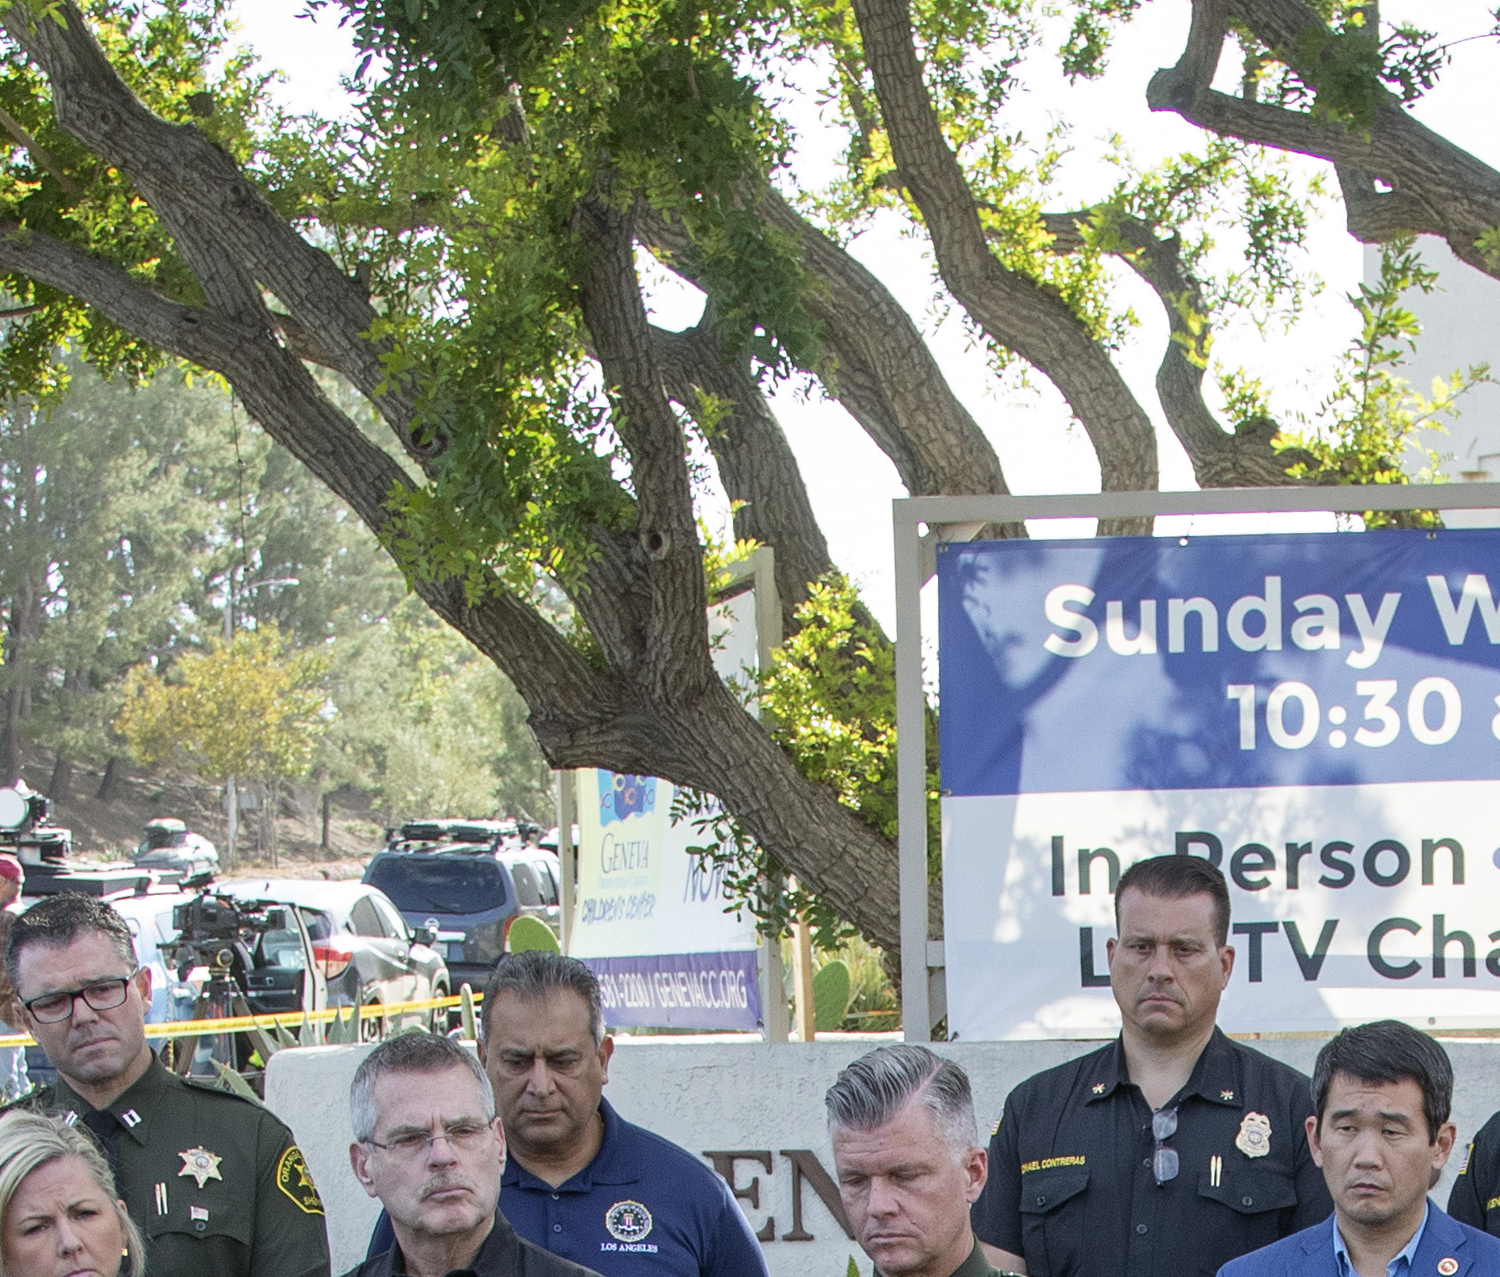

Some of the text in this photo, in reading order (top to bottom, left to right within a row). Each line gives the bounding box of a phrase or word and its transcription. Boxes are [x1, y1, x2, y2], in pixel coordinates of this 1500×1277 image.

[1043, 574, 1401, 669] Sunday
[1227, 676, 1461, 752] 10:30
[1232, 918, 1342, 982] TV
[1041, 1155, 1086, 1169] CONTRERAS
[601, 1243, 658, 1253] LOS ANGELES
